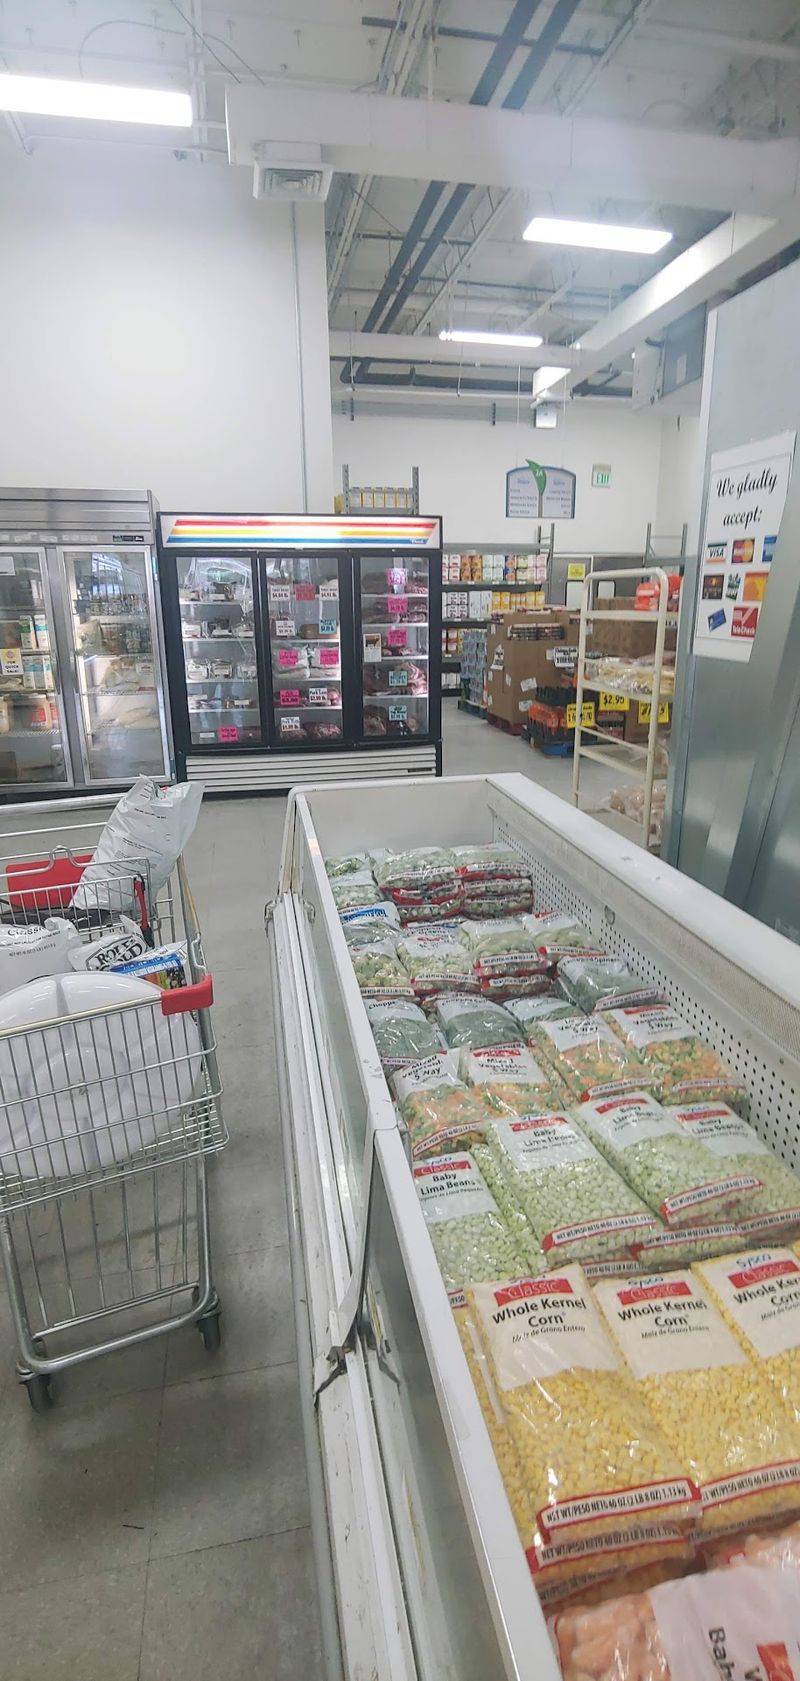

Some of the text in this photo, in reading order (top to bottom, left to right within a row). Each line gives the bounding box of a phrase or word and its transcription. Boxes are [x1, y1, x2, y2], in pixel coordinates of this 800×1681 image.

[716, 467, 778, 499] We gladly
[723, 505, 763, 530] accept:
[709, 547, 725, 559] VISA
[533, 1128, 556, 1138] Baby
[432, 1172, 457, 1182] Baby
[420, 1179, 476, 1196] Lima Beans
[507, 1280, 558, 1299] Classic
[733, 1284, 777, 1304] Whole
[492, 1297, 588, 1325] Whole Kernel
[618, 1299, 708, 1321] Whole Kernel
[530, 1326, 540, 1336] de
[546, 1508, 560, 1523] NET
[561, 1503, 591, 1519] WT/PESO
[608, 1499, 617, 1509] 40
[644, 1493, 650, 1501] 8
[676, 1486, 687, 1497] kg
